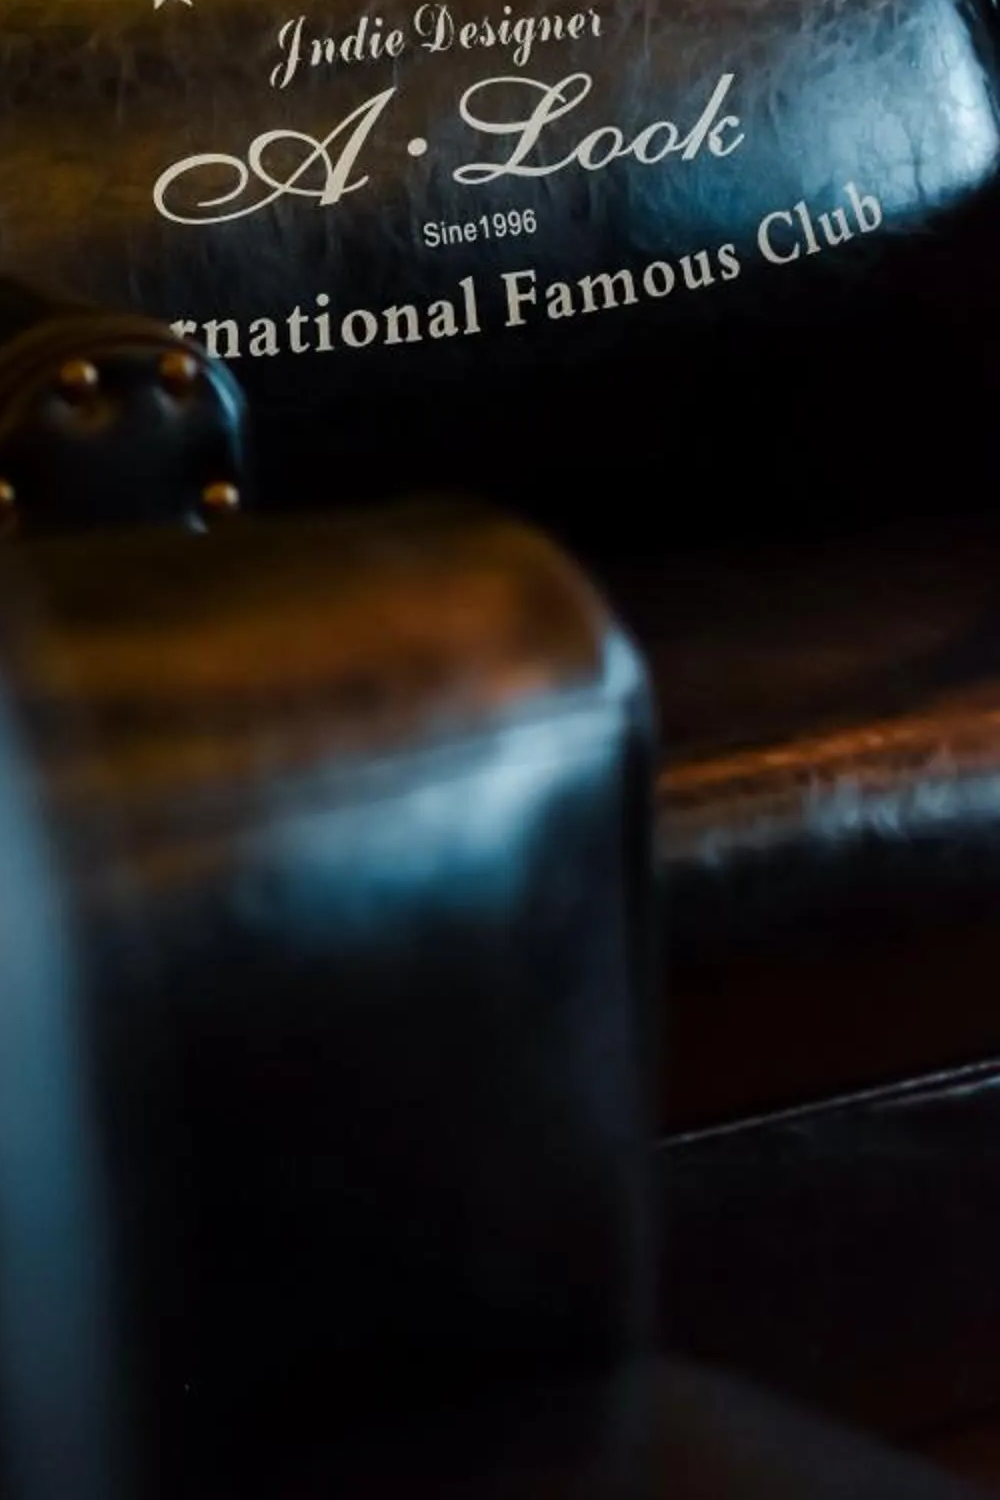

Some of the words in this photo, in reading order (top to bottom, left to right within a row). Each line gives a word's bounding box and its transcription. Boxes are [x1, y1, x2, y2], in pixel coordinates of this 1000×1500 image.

[414, 3, 602, 65] Designer
[153, 87, 396, 225] A
[452, 73, 744, 185] Look
[423, 209, 537, 248] Sine1996
[501, 241, 740, 326] Famous
[757, 182, 884, 264] Club
